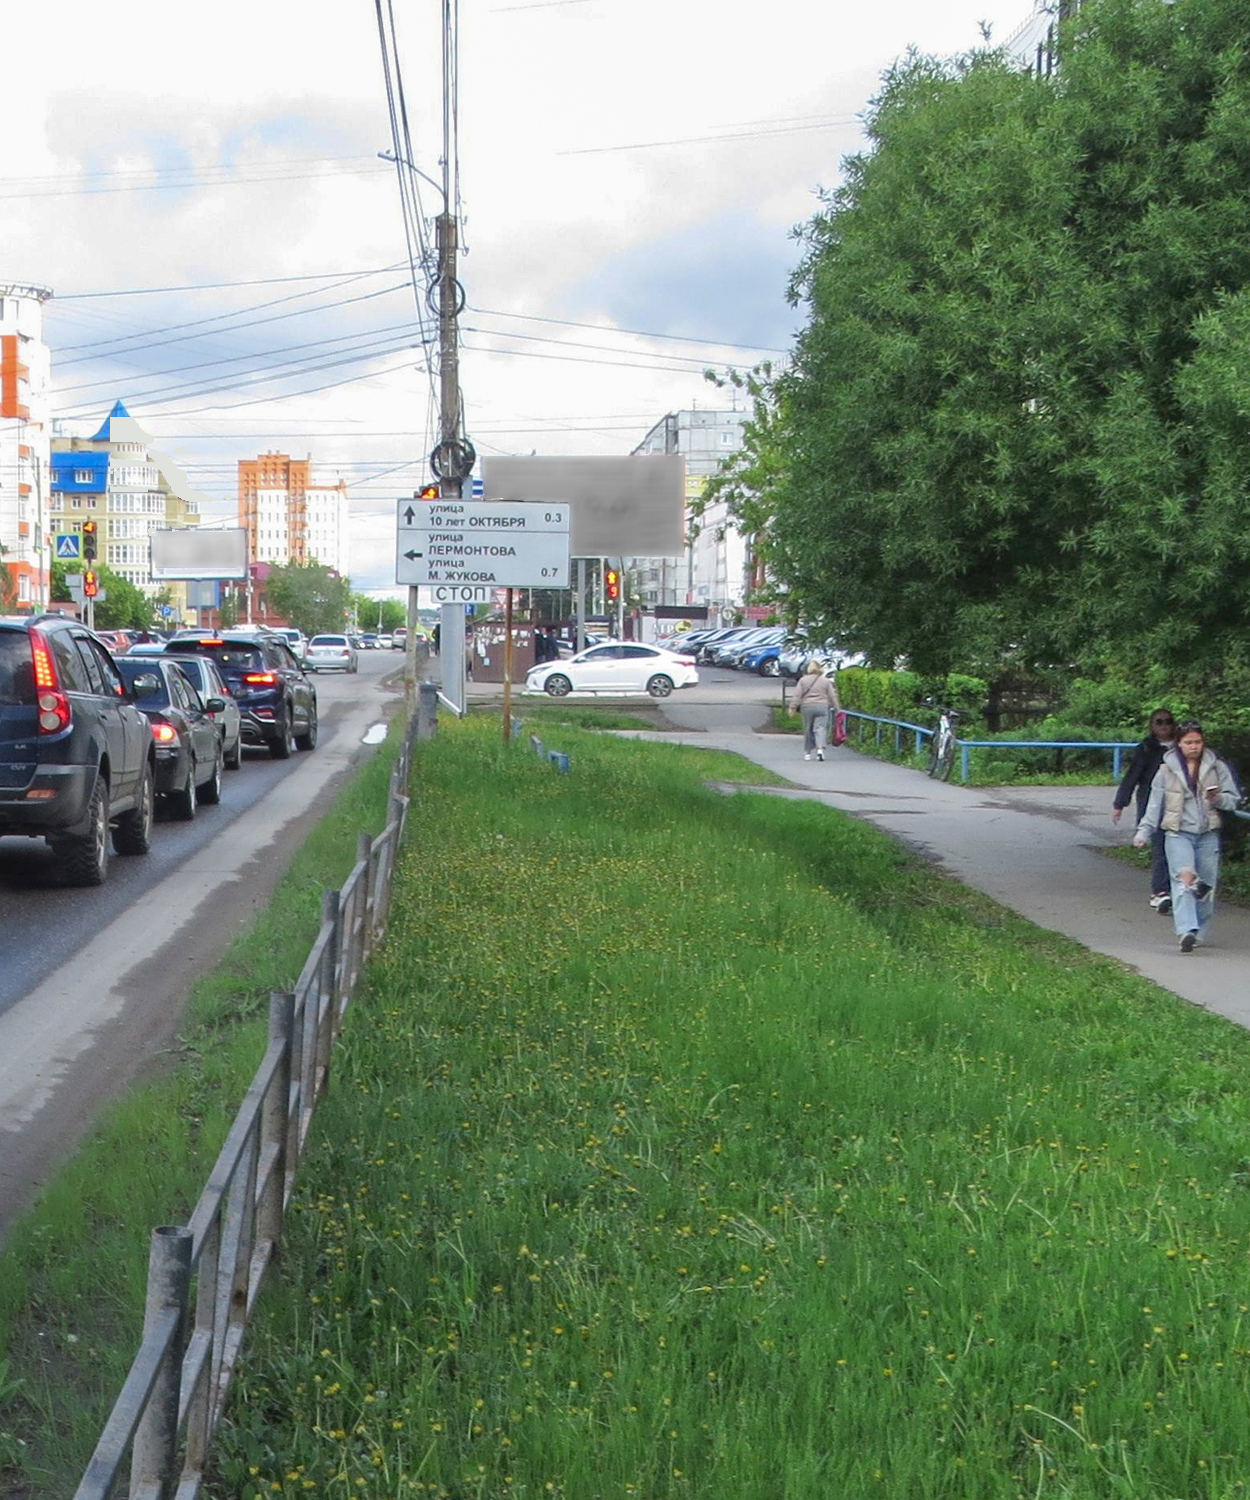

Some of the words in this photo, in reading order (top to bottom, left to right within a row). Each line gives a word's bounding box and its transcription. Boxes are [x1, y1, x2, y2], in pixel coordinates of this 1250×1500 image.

[428, 504, 465, 515] улица
[429, 516, 442, 527] 10
[445, 519, 465, 527] лет
[468, 516, 526, 528] ОКТЯБРЯ
[544, 512, 562, 523] 0.3
[428, 533, 464, 543] улица
[428, 546, 517, 557] ЛЕРМОНТОВА
[428, 558, 465, 568] улица
[428, 571, 442, 581] М.
[445, 570, 496, 582] ЖУКОВА
[540, 567, 558, 578] 0.7
[435, 586, 486, 601] СТОП
